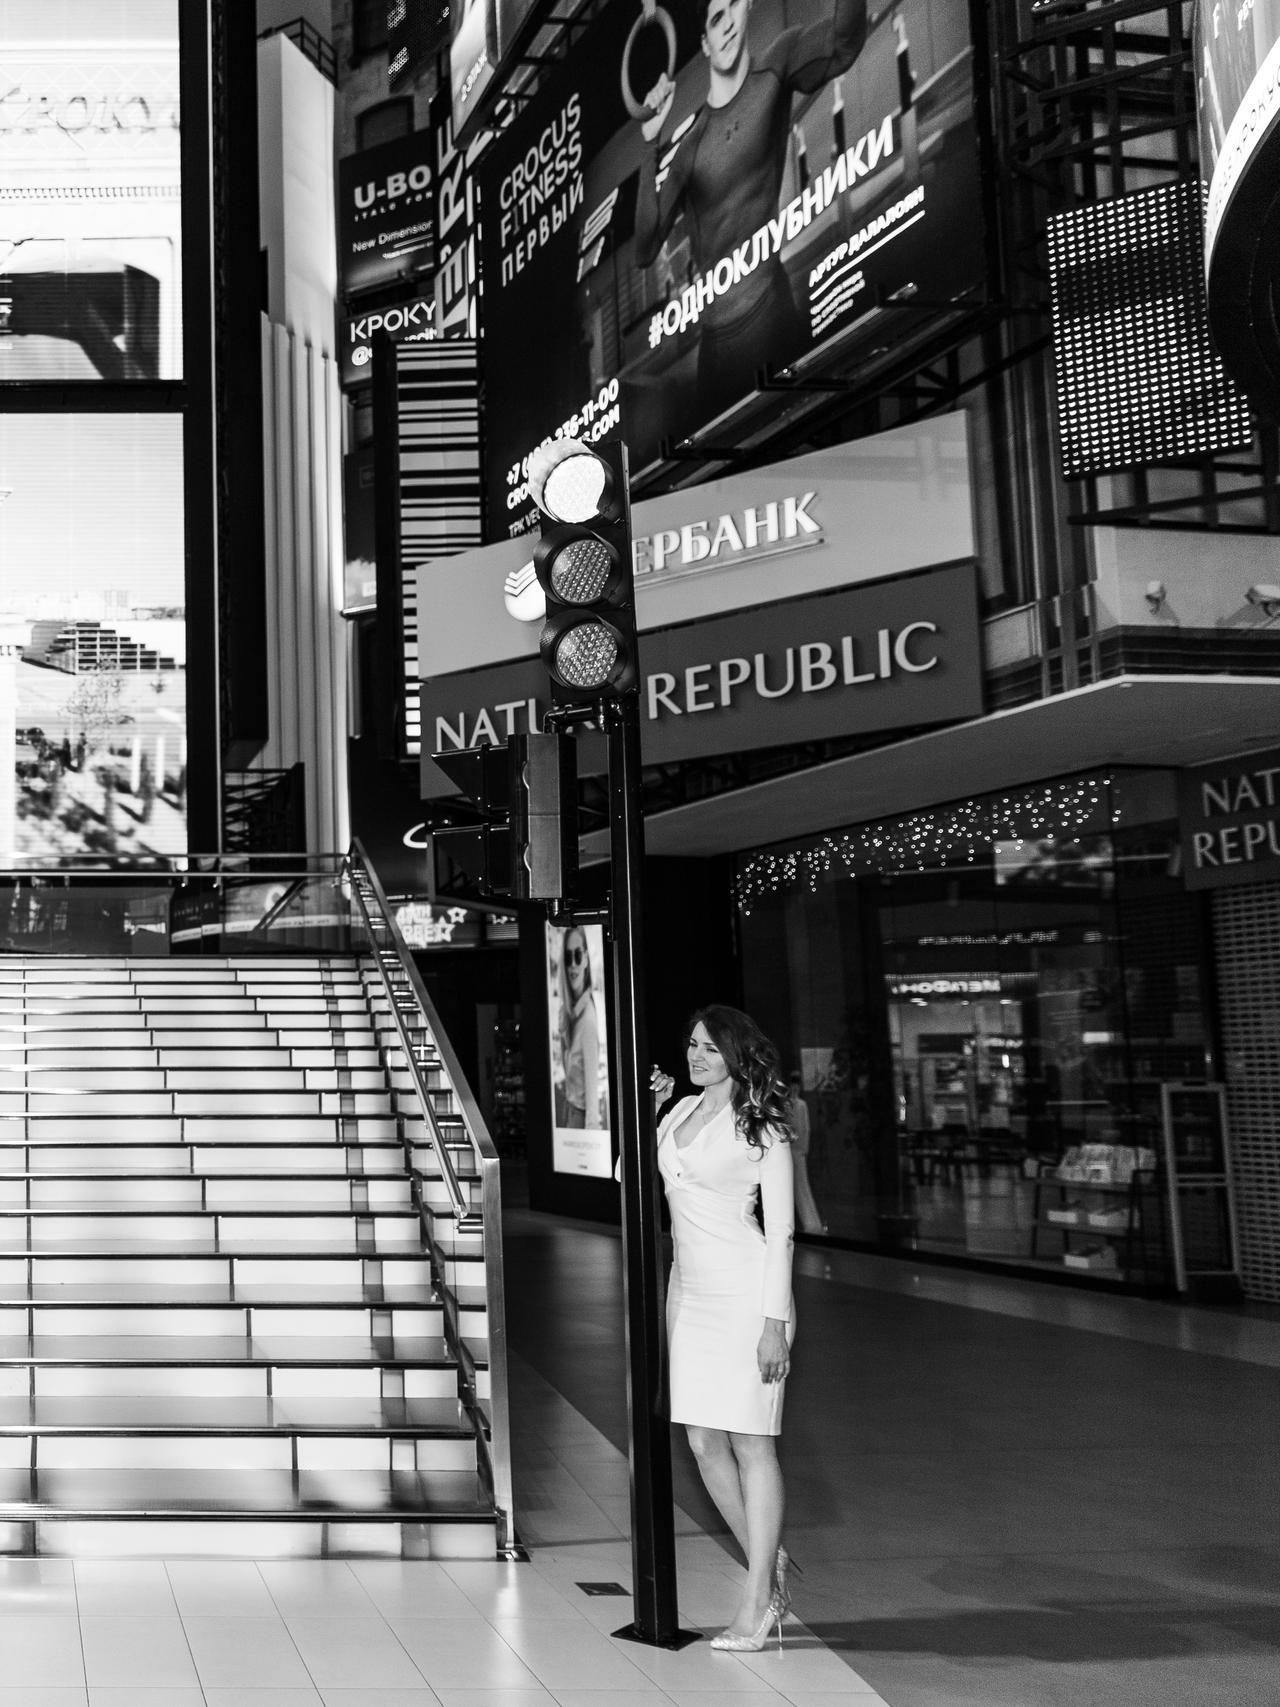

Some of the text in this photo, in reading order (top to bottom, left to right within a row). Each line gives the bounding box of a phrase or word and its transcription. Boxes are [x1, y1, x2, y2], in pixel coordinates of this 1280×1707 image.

[353, 164, 432, 209] U-BO
[500, 93, 581, 210] CROCUS
[500, 131, 582, 248] FITNESS
[352, 239, 376, 253] New
[502, 170, 584, 287] ПЕРВЫЙ
[648, 114, 894, 349] #ОДНОКЛУБНИКИ
[351, 300, 437, 342] КРОКУ
[632, 491, 822, 577] ЕРБАНК
[646, 621, 938, 720] REPUBLIC
